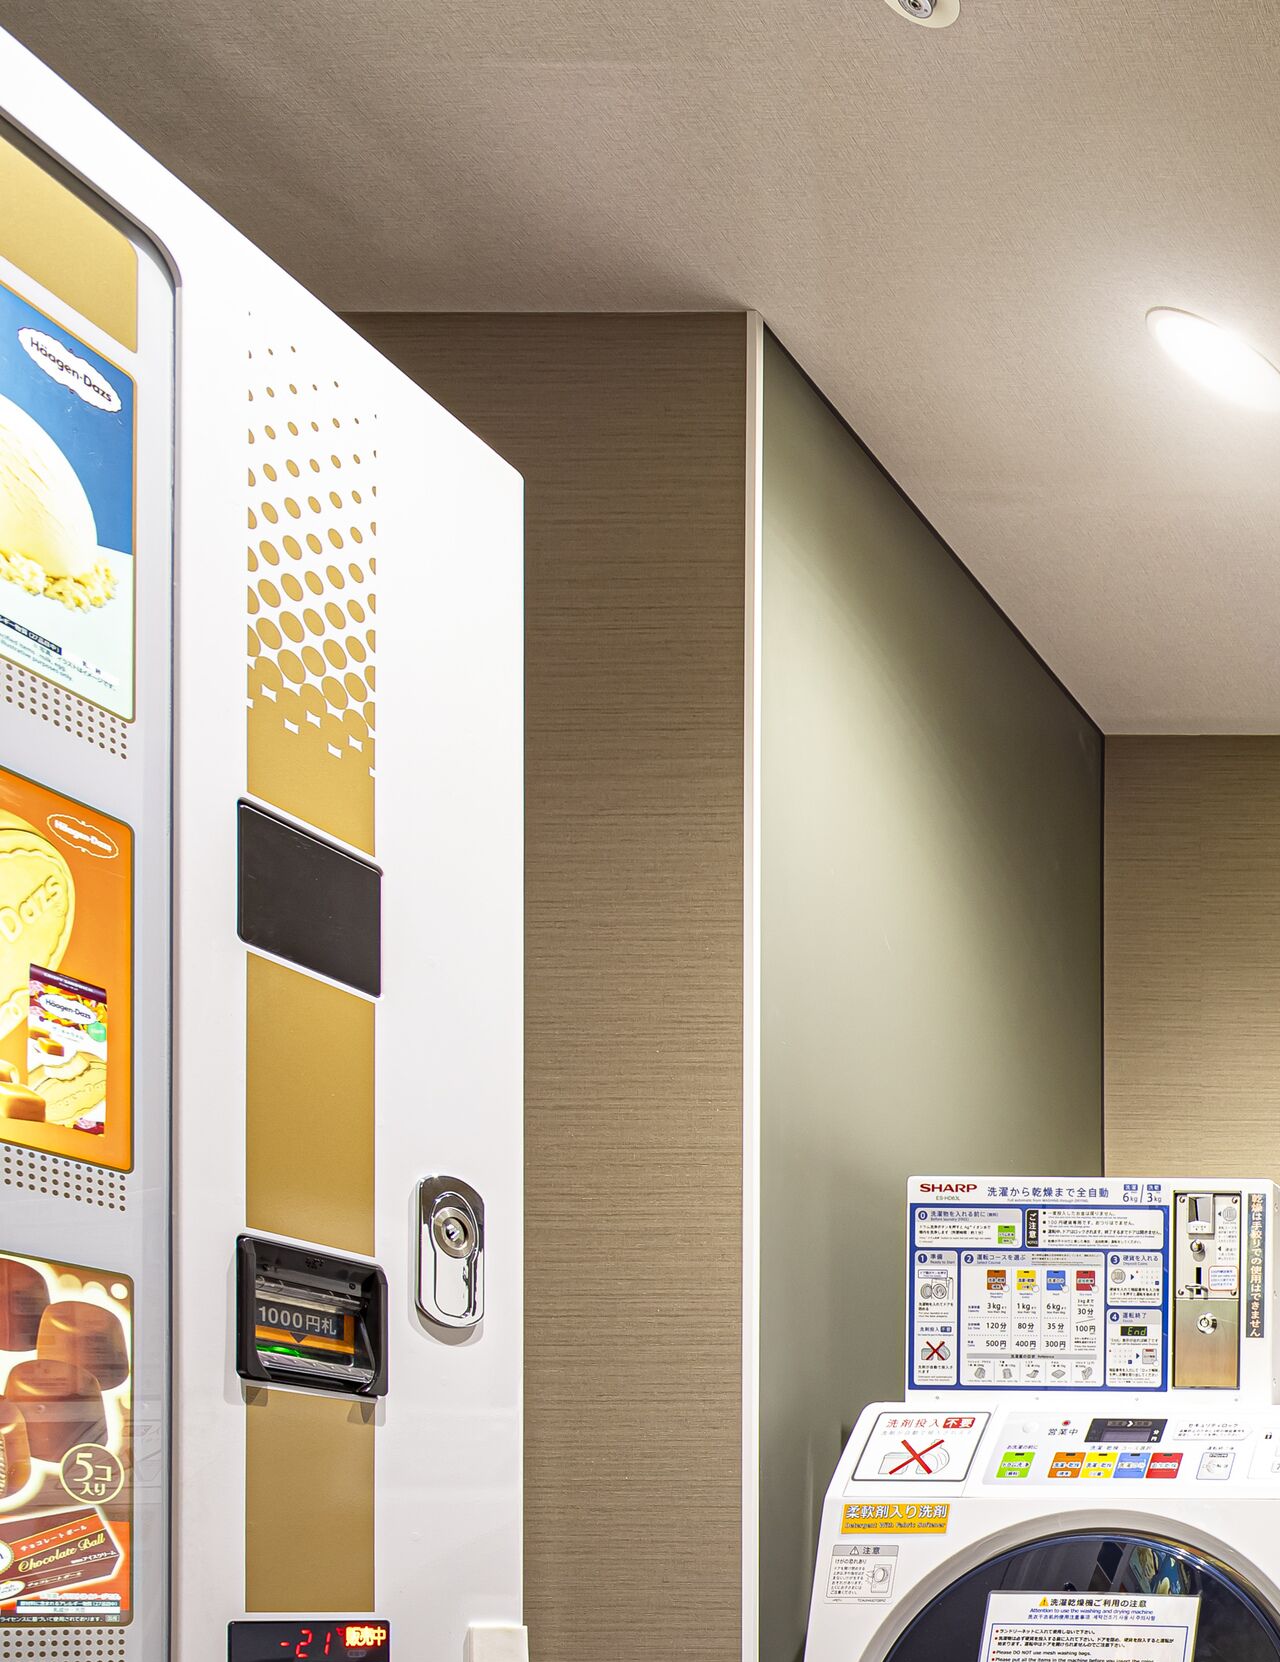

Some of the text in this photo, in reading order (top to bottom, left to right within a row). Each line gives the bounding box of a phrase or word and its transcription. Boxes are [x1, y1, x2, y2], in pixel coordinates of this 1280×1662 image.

[29, 336, 112, 404] Häagen-Dazs
[54, 819, 112, 853] Häagen-Dazs
[45, 998, 91, 1019] Häagen-Dazs
[920, 1184, 977, 1193] SHARP
[988, 1187, 1109, 1198] 洗濯から乾燥まで全自動
[1250, 1194, 1262, 1337] 乾燥は手絞りでの使用はできません
[258, 1305, 338, 1336] 1000円札
[886, 1418, 974, 1428] 洗剤投入 不要
[846, 1504, 948, 1520] 柔軟剤入り洗剤
[18, 1533, 105, 1572] Chocolate Ball
[1050, 1598, 1147, 1608] 洗濯乾燥機ご利用の注意
[345, 1626, 386, 1647] 販売中
